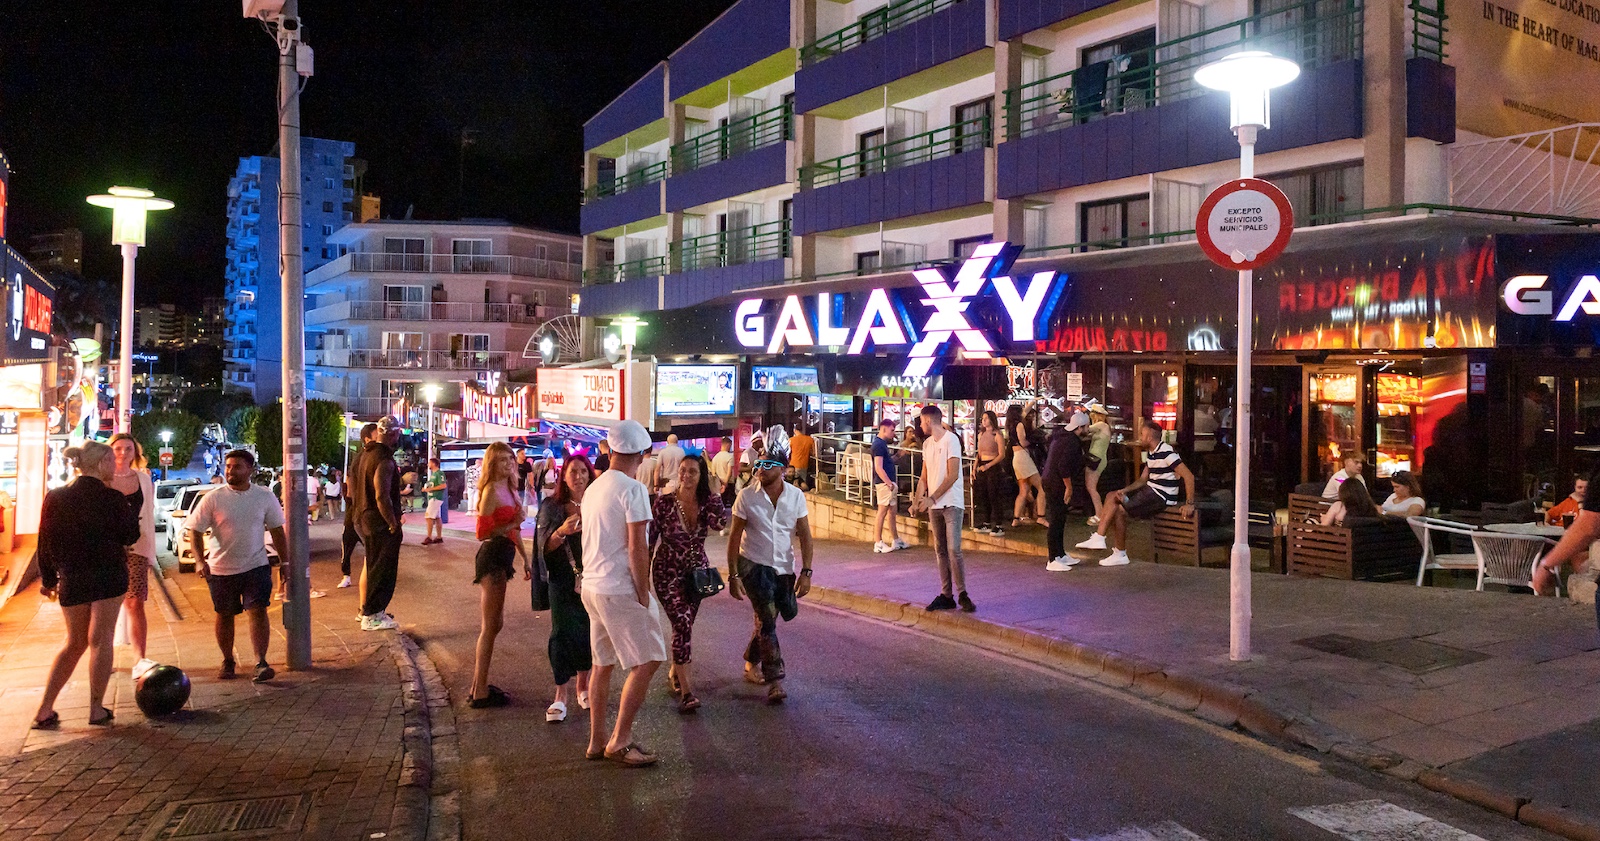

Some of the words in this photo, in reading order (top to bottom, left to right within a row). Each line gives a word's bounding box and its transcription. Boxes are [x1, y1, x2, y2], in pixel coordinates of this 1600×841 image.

[1483, 1, 1495, 21] IN
[1498, 6, 1520, 31] THE
[1522, 16, 1559, 47] HEART
[1561, 33, 1575, 51] OF
[1576, 38, 1600, 62] MAG
[1227, 207, 1262, 215] EXCEPTO
[1219, 224, 1268, 232] MUNICIPALES
[1224, 216, 1263, 224] SERVICIOS
[734, 241, 1058, 377] GALAXY
[881, 375, 930, 392] GALAXY
[463, 381, 492, 423] NIGHT
[492, 386, 528, 429] FLIGHT
